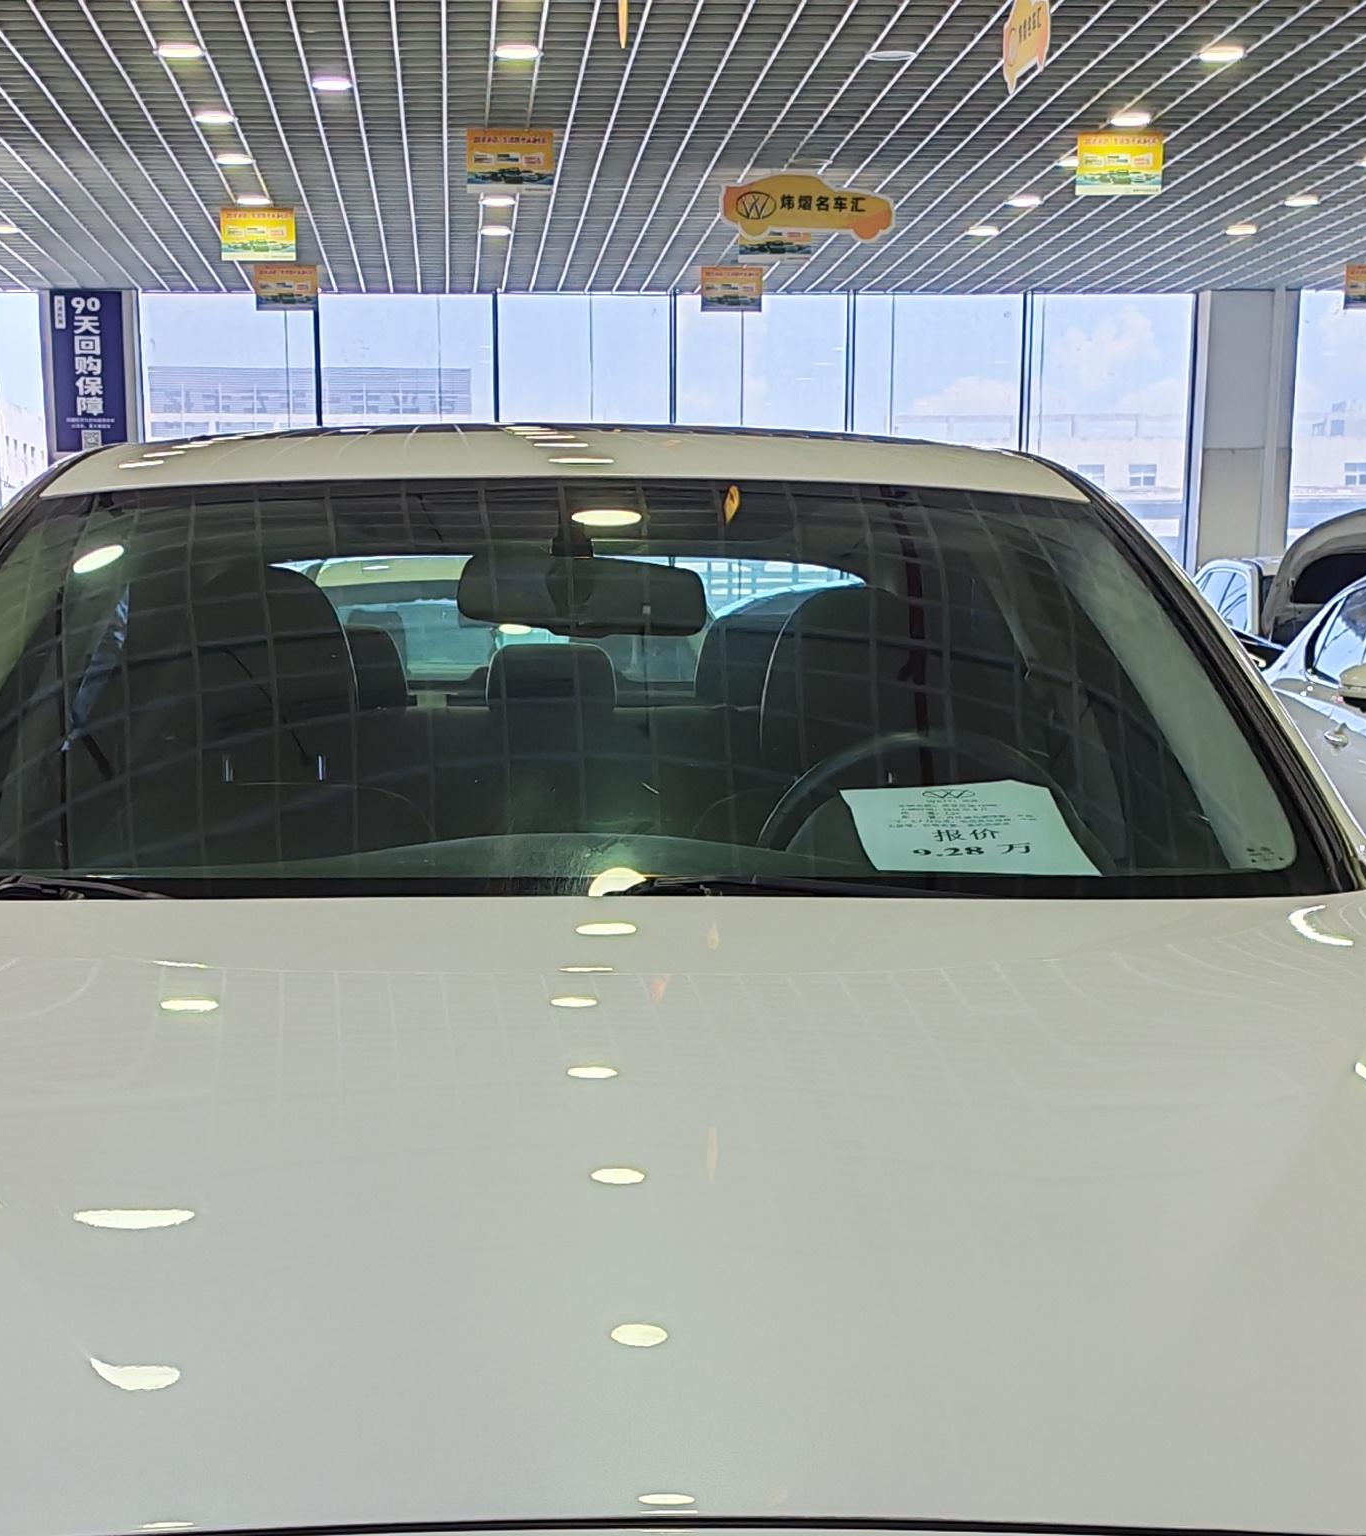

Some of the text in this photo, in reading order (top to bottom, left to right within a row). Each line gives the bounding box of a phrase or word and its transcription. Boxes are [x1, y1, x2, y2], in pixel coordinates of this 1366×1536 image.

[779, 193, 867, 213] 炜熠名车汇
[70, 297, 105, 416] 90天回购保障
[932, 828, 1003, 843] 报价
[912, 842, 1032, 857] 9.28 万
